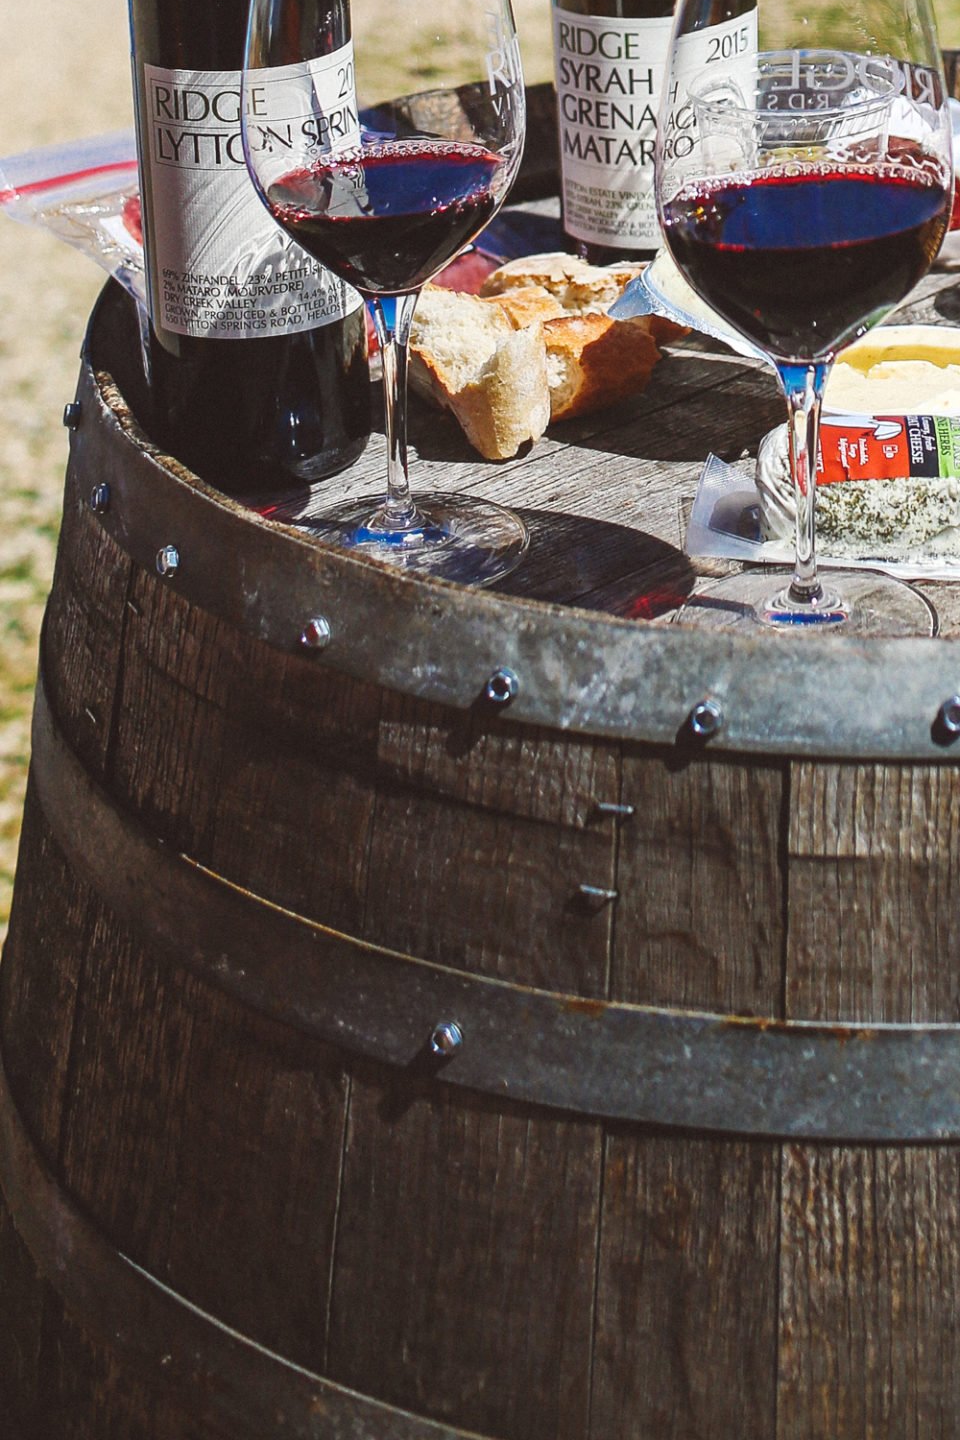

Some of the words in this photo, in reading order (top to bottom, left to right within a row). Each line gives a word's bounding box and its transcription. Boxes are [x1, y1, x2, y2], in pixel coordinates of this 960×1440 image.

[559, 21, 640, 60] RIDGE
[705, 27, 749, 64] 2015
[560, 58, 653, 95] SYRAH
[155, 86, 268, 123] RIDGE
[158, 125, 294, 166] LYTTON
[563, 127, 695, 168] MATARO
[177, 283, 221, 298] MATARO
[223, 280, 304, 298] (MOURVEDRE)
[247, 273, 272, 285] 23%
[275, 267, 309, 283] PETITE
[164, 291, 180, 304] DRY
[183, 296, 214, 309] CREEK
[216, 299, 257, 309] VALLEY
[298, 287, 327, 302] 14.4%
[204, 309, 266, 320] PRODUCED
[269, 308, 277, 318] &
[281, 298, 326, 317] BOTTLED
[327, 292, 338, 305] BY
[180, 317, 218, 330] LYTTON
[220, 318, 267, 331] SPRINGS
[270, 313, 305, 328] ROAD,
[909, 428, 924, 464] CHEESE
[938, 428, 951, 456] HERBS
